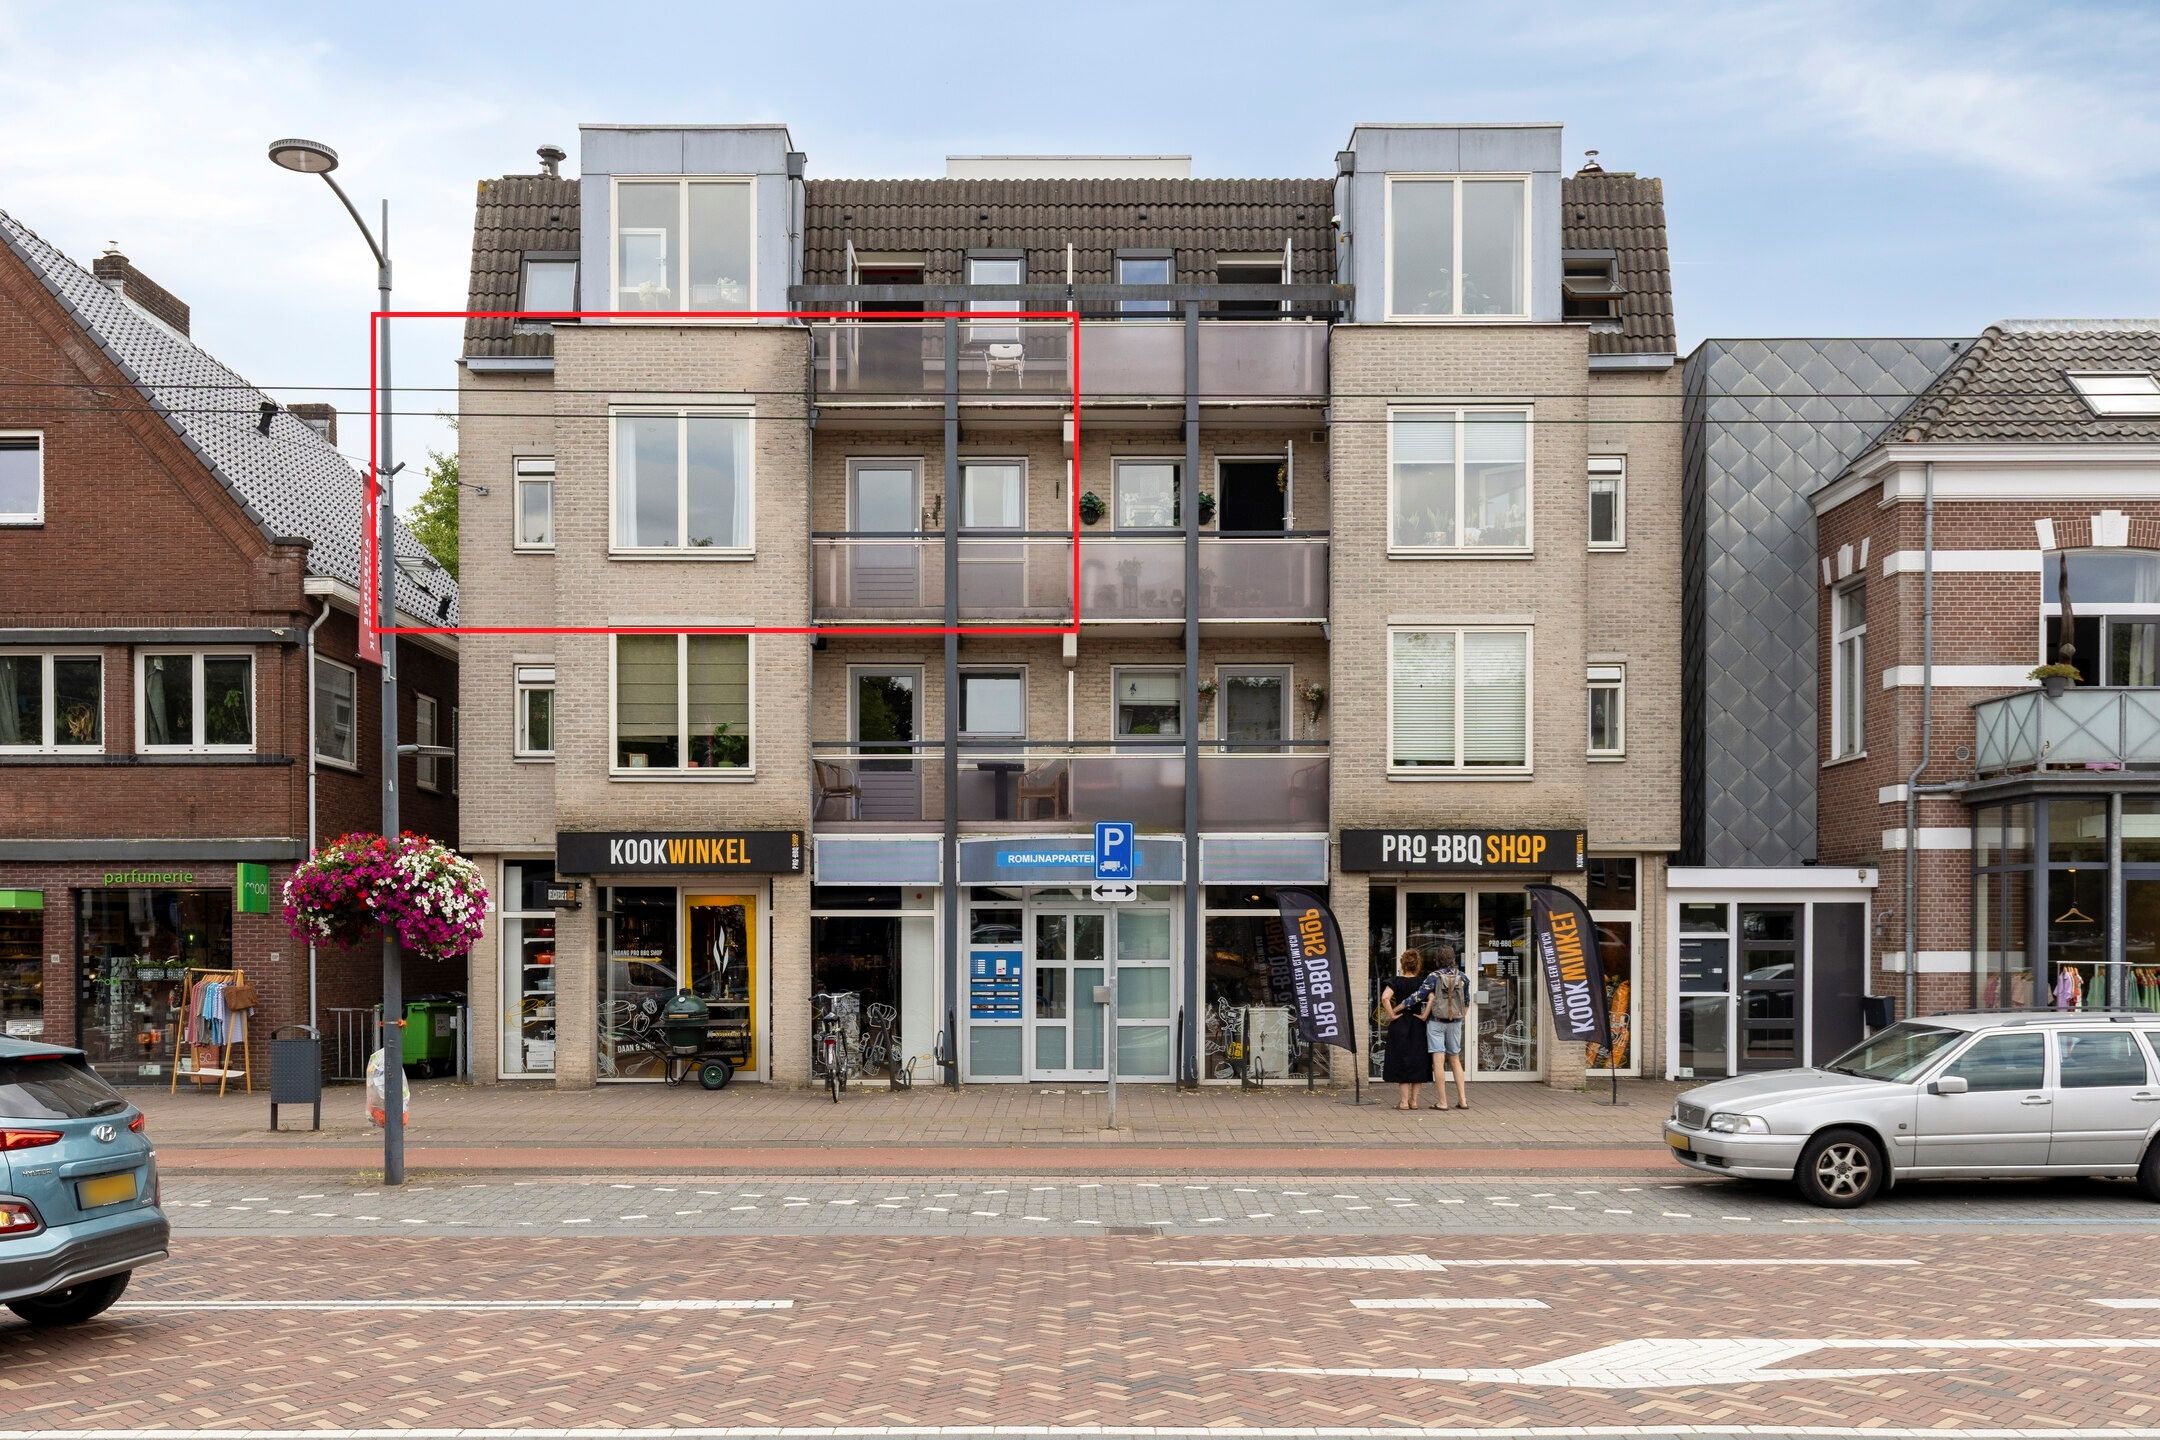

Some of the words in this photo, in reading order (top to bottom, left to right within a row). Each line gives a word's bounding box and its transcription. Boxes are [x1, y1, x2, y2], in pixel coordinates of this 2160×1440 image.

[610, 838, 751, 865] KOOKWINKEL
[1104, 827, 1125, 857] P
[1486, 834, 1546, 864] SHOP
[104, 869, 193, 886] parfumerie
